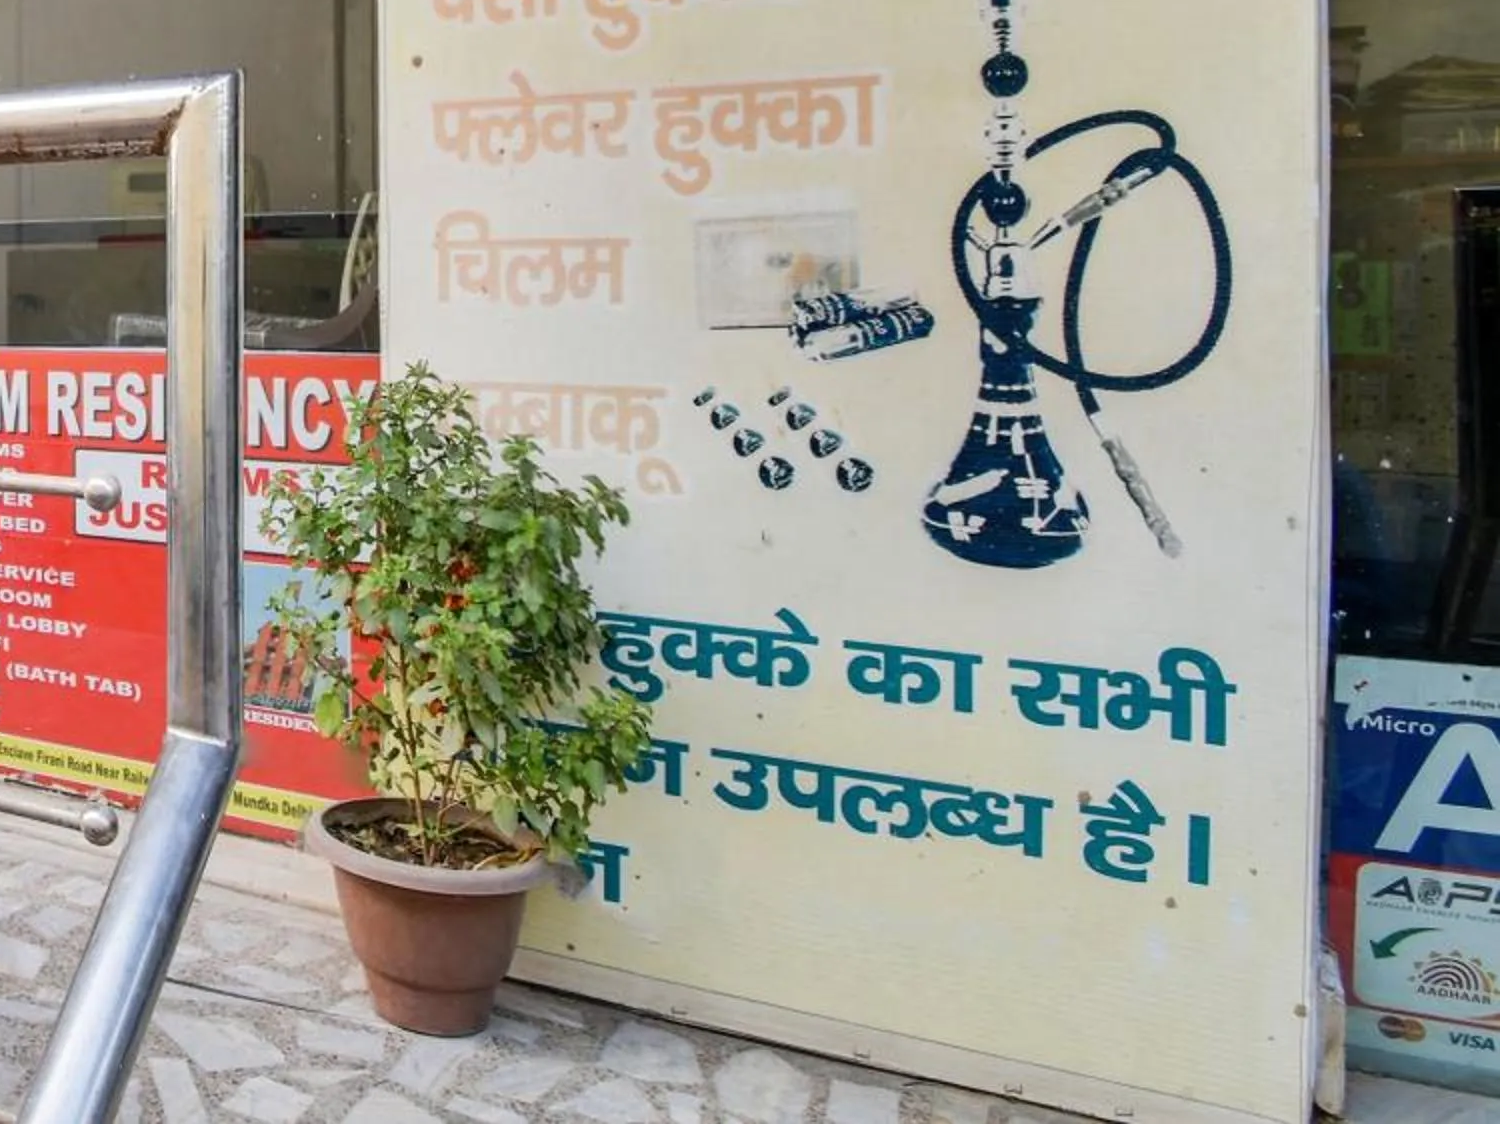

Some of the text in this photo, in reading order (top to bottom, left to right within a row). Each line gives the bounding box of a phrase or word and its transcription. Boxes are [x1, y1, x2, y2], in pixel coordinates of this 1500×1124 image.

[432, 71, 880, 196] फ्लेवर हुक्का
[433, 210, 630, 306] चिलम
[47, 369, 377, 452] RESINCY
[0, 517, 45, 534] BED
[8, 613, 88, 639] LOBBY
[6, 661, 142, 702] (BATH TAB)
[597, 607, 1236, 747] हुक्के का सभी
[1362, 714, 1436, 736] Micro
[68, 756, 93, 774] Road
[95, 762, 120, 779] Near
[233, 791, 278, 814] Mundka
[711, 745, 1053, 859] उपलब्ध
[1417, 984, 1491, 1005] AADHAAR
[1449, 1032, 1496, 1052] VISA
